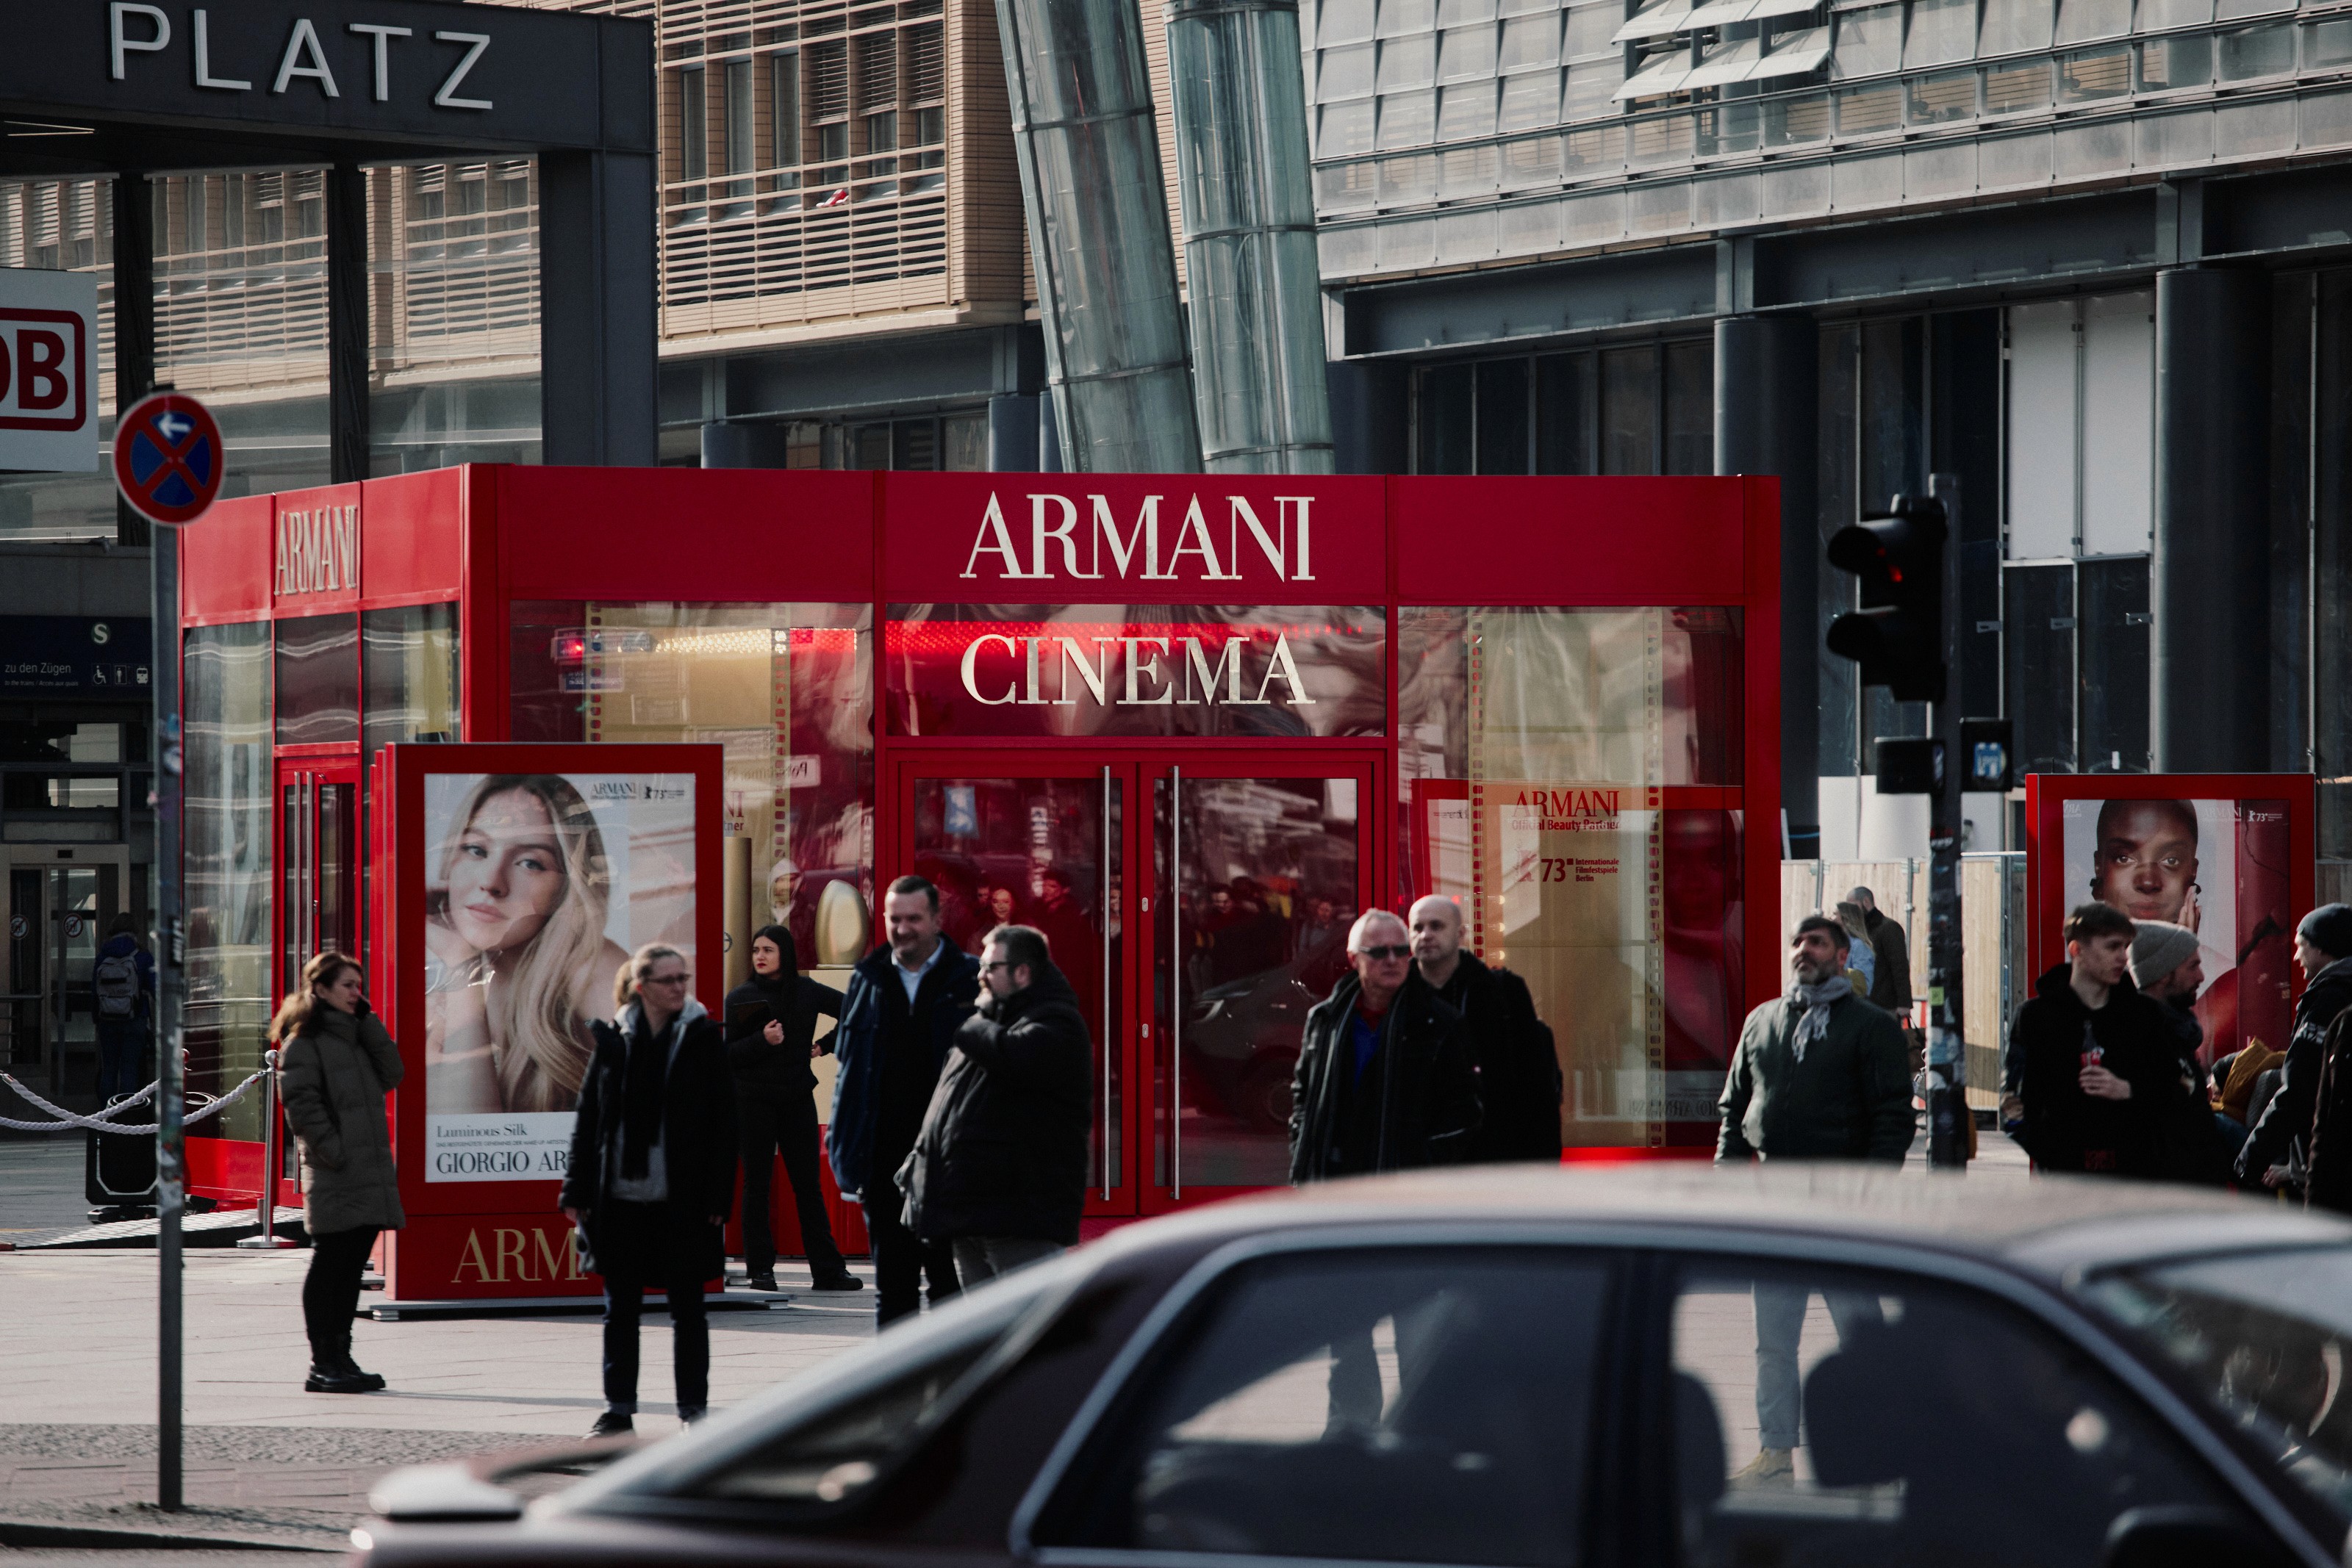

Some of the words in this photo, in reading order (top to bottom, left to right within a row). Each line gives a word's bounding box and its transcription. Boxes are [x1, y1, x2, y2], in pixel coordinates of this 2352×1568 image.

[110, 1, 493, 109] PLATZ
[0, 328, 68, 409] B
[959, 490, 1316, 582] ARMANI
[274, 505, 358, 596] ARMANI
[94, 624, 108, 644] S
[5, 664, 16, 673] zu
[20, 663, 37, 673] den
[40, 663, 71, 675] Zügen
[961, 632, 1316, 707] CINEMA
[591, 783, 637, 794] ARMANI
[1512, 791, 1620, 817] ARMANI
[1548, 819, 1582, 832] Beauty
[1583, 819, 1620, 831] Partner
[1576, 866, 1618, 874] Filmfestspiele
[437, 1126, 501, 1138] Luminous
[504, 1123, 528, 1136] Silk
[437, 1151, 530, 1173] GIORGIO
